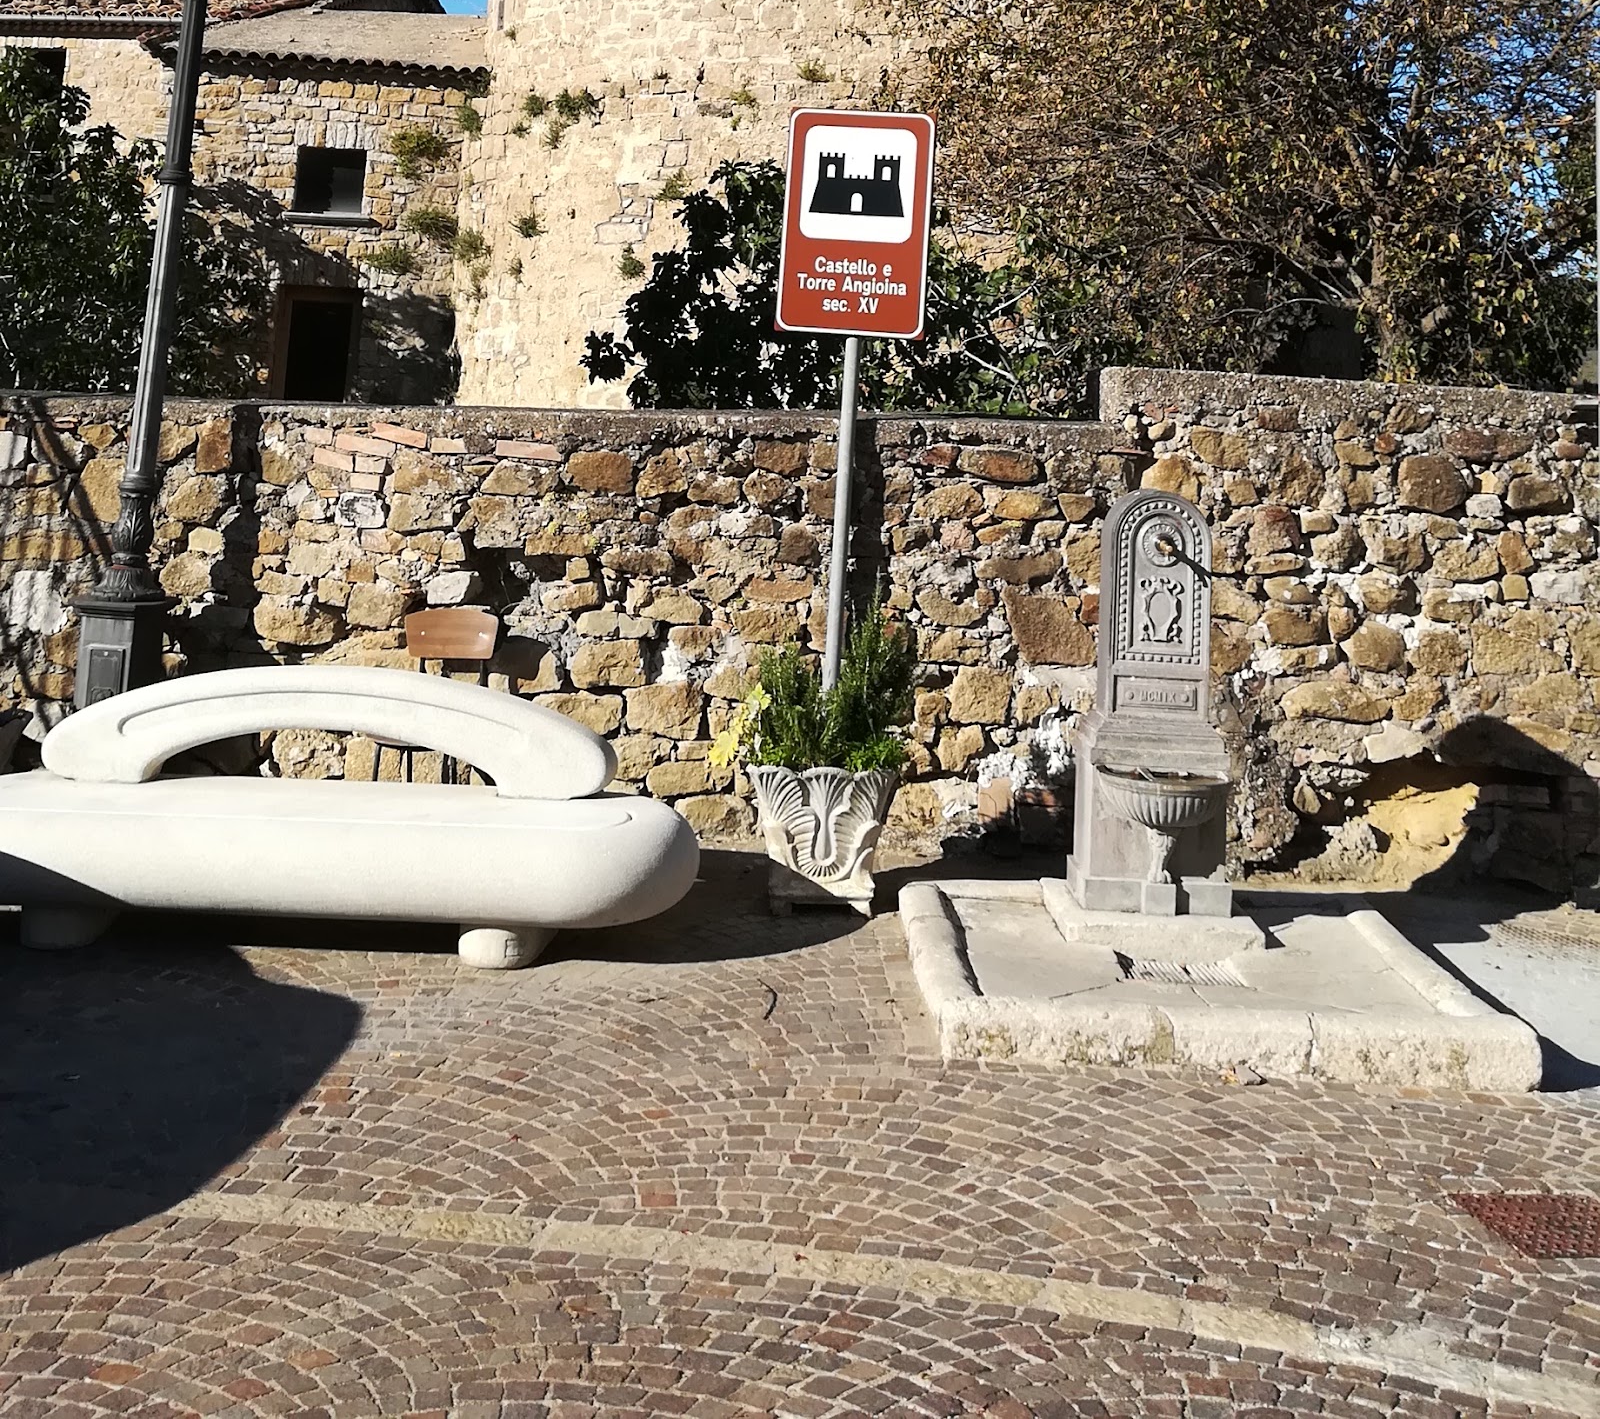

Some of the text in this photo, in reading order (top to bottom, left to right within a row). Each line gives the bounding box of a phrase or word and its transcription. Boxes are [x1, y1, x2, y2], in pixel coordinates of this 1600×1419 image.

[815, 256, 892, 277] Castello e
[797, 273, 907, 296] Torre Angioina
[822, 297, 879, 314] sec. XV
